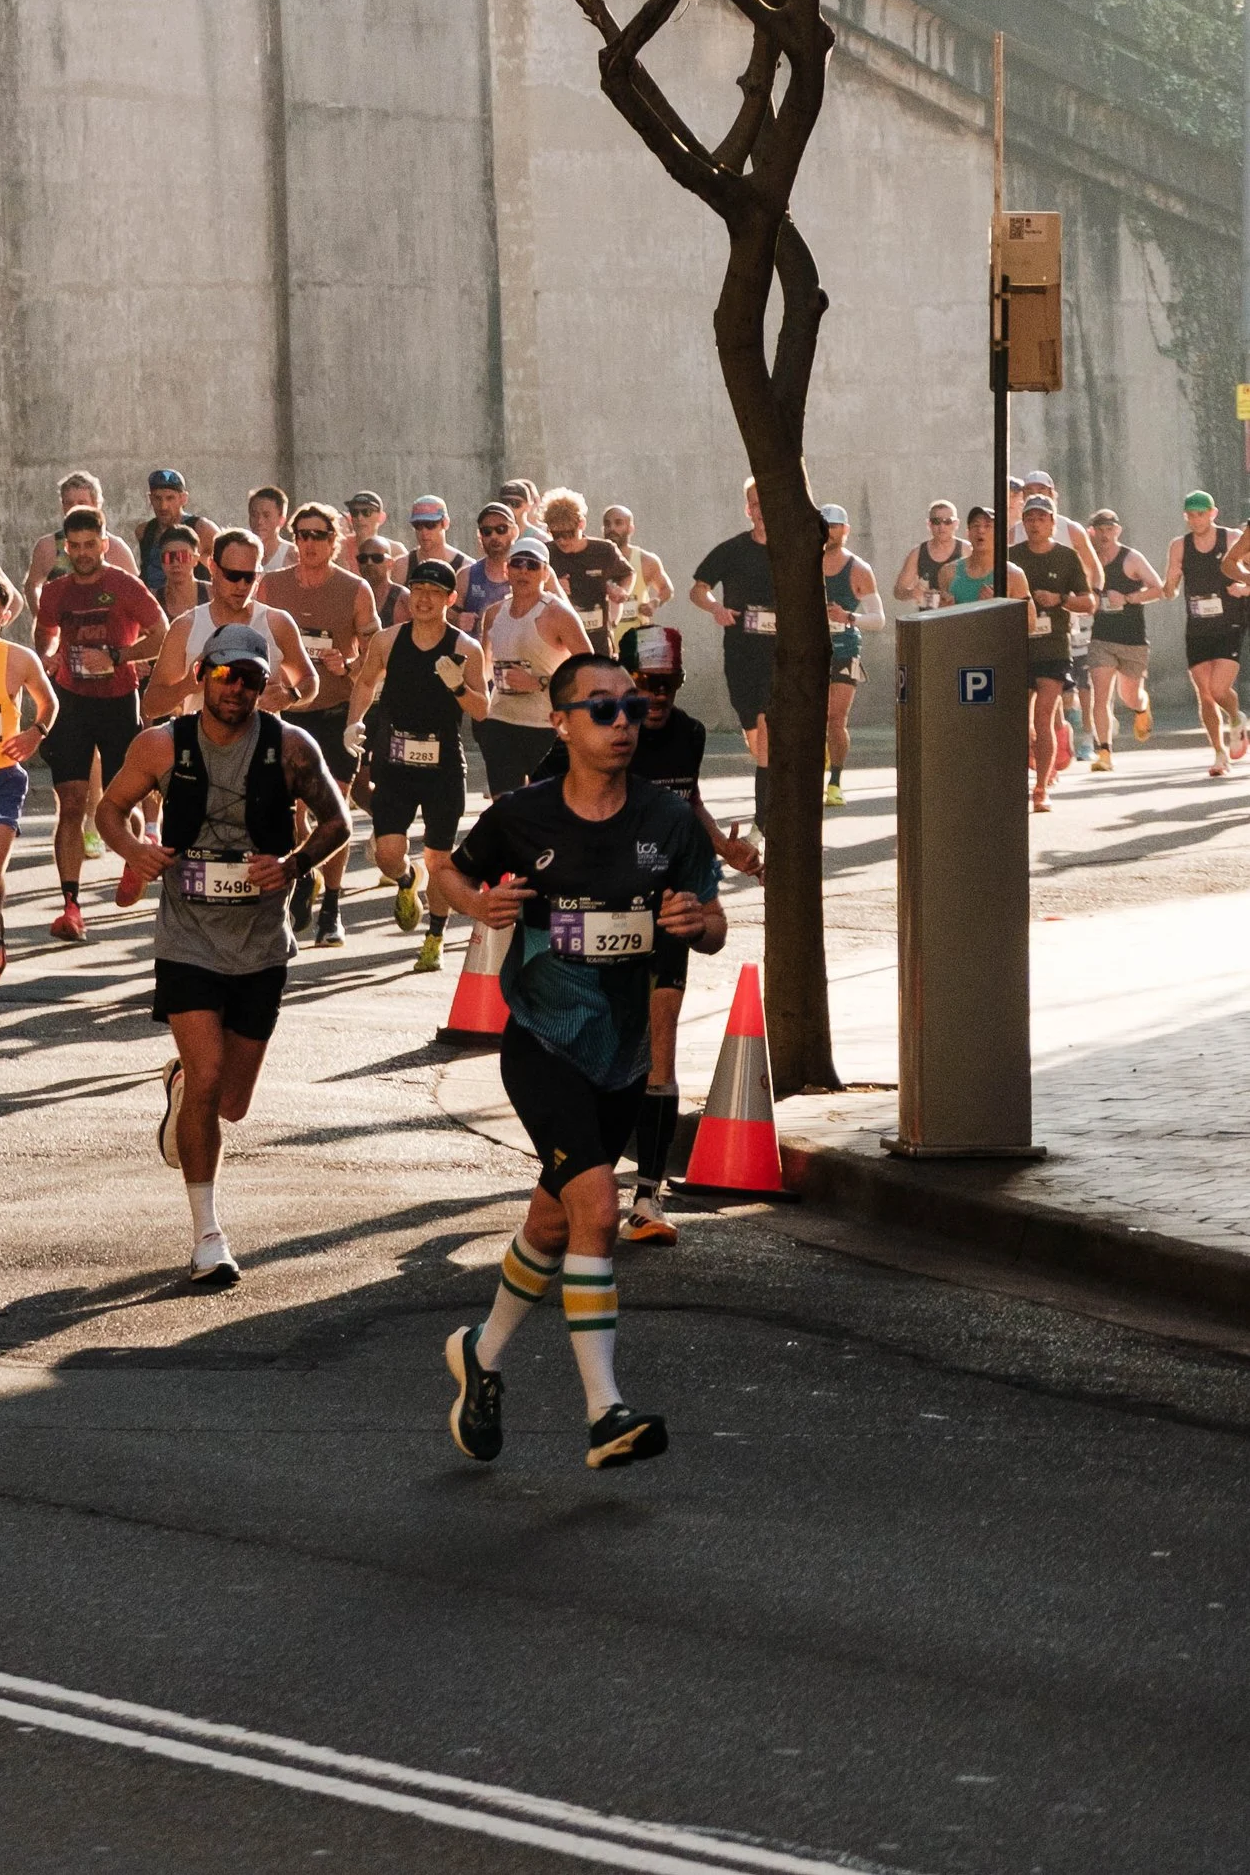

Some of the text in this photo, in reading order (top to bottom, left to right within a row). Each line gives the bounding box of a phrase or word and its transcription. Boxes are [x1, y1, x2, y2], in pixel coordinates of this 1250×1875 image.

[966, 672, 988, 701] P
[409, 751, 434, 761] 2283
[187, 848, 201, 859] tcs
[636, 840, 658, 854] tcs
[185, 879, 252, 894] 1 B 3496
[558, 896, 578, 910] tcs
[556, 933, 642, 952] 1 B 3279
